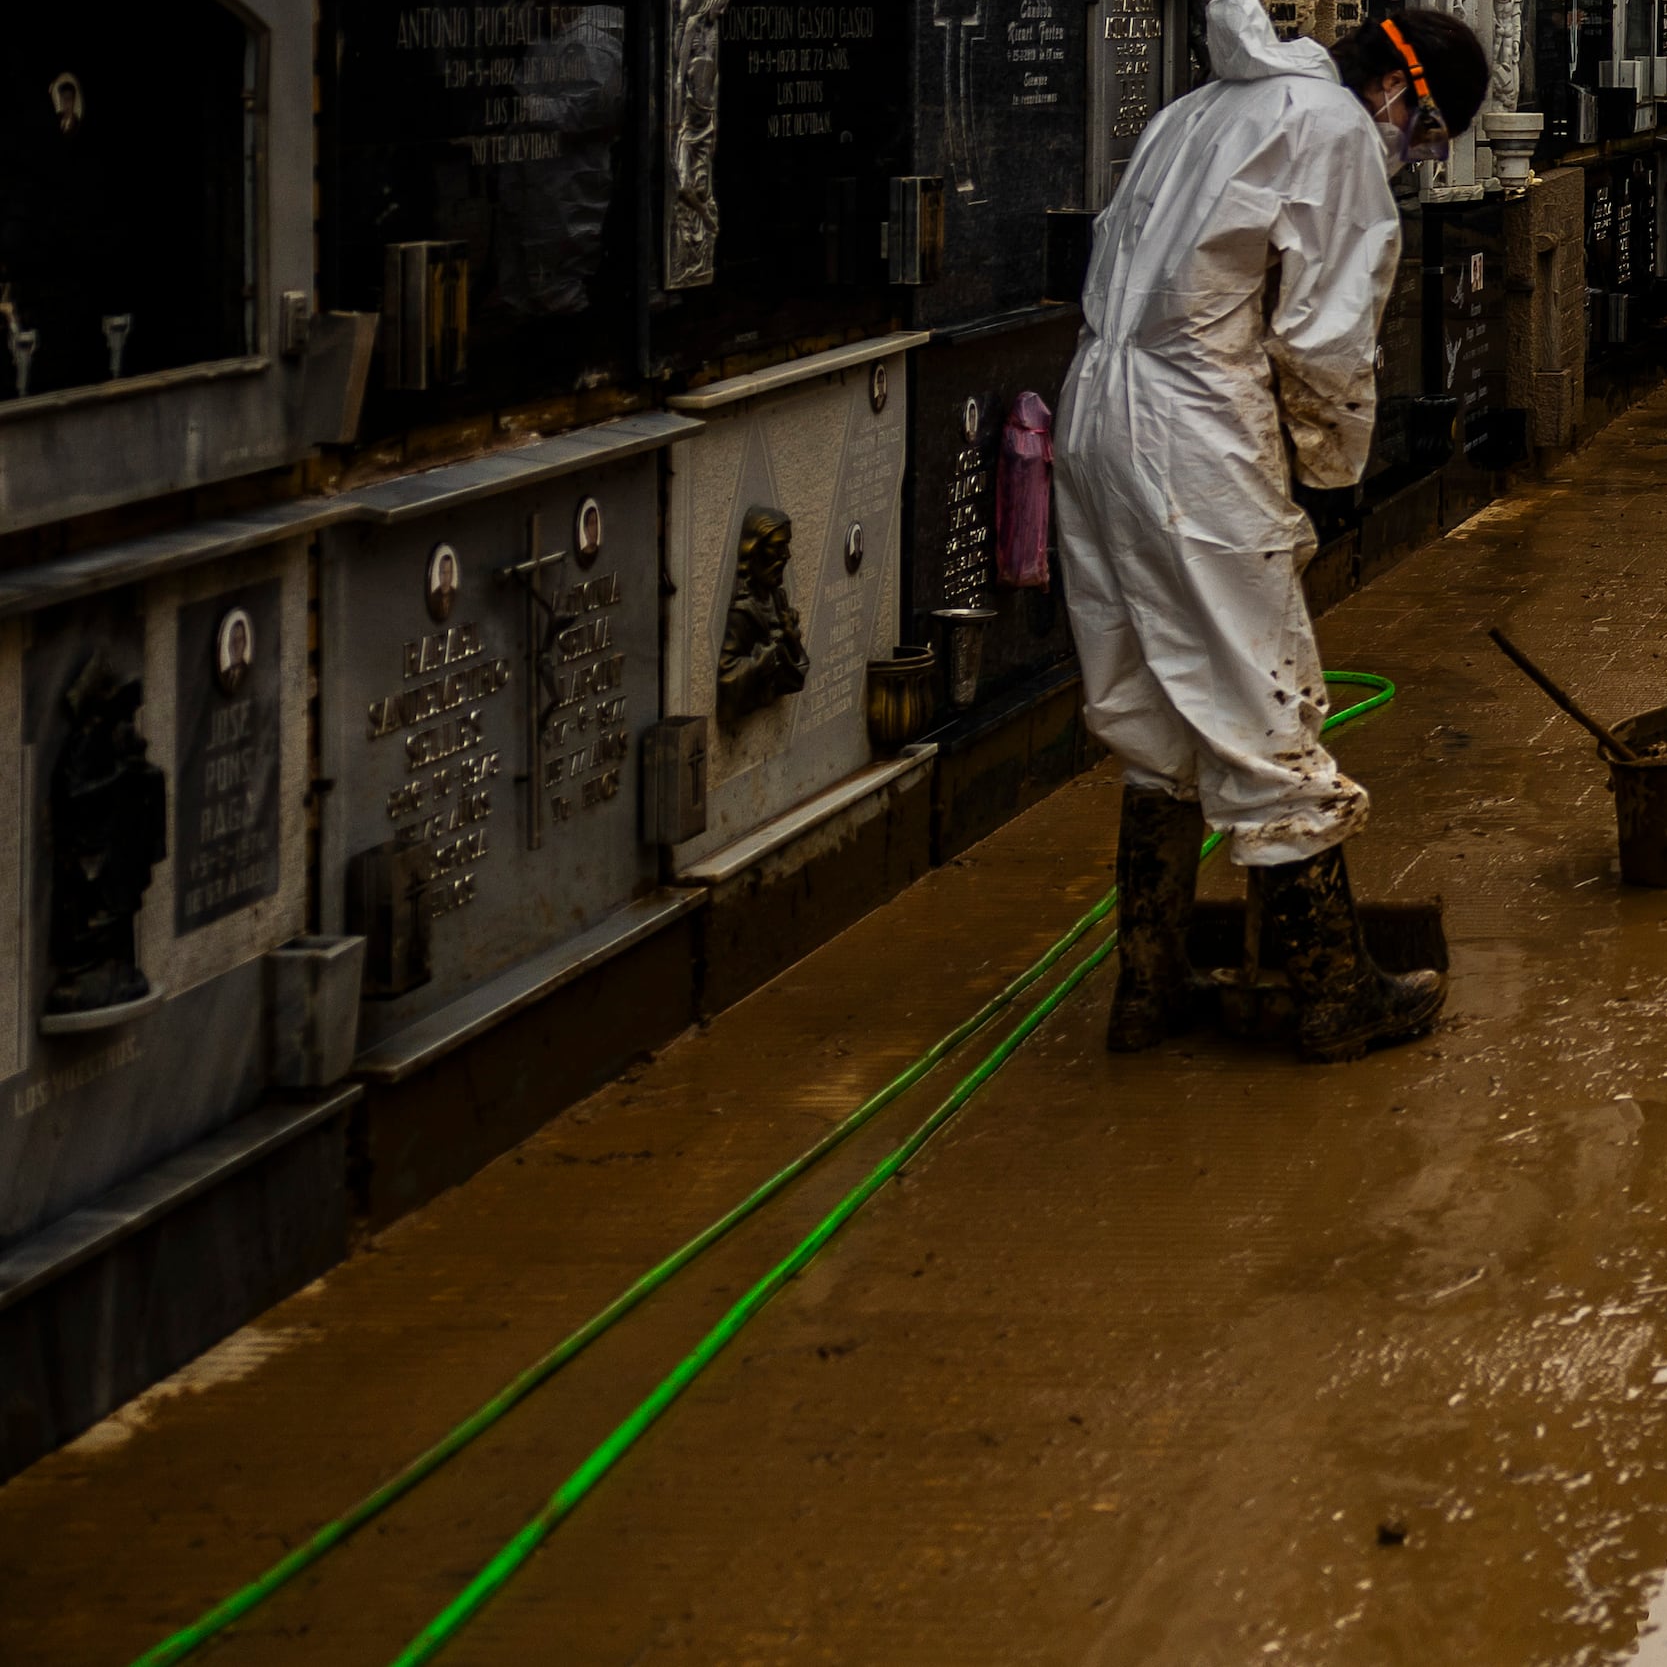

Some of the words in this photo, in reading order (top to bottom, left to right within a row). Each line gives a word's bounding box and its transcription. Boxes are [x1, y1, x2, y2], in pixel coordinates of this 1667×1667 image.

[395, 6, 468, 50] ANTONIO
[473, 6, 545, 48] PUCHALT
[721, 6, 794, 41] CONCEPCION
[797, 6, 836, 40] GASCO
[839, 6, 875, 39] GASCO
[485, 96, 510, 125] LOS
[777, 81, 794, 106] LOS
[795, 80, 824, 104] TUYOS
[402, 622, 484, 678] RAFAEL
